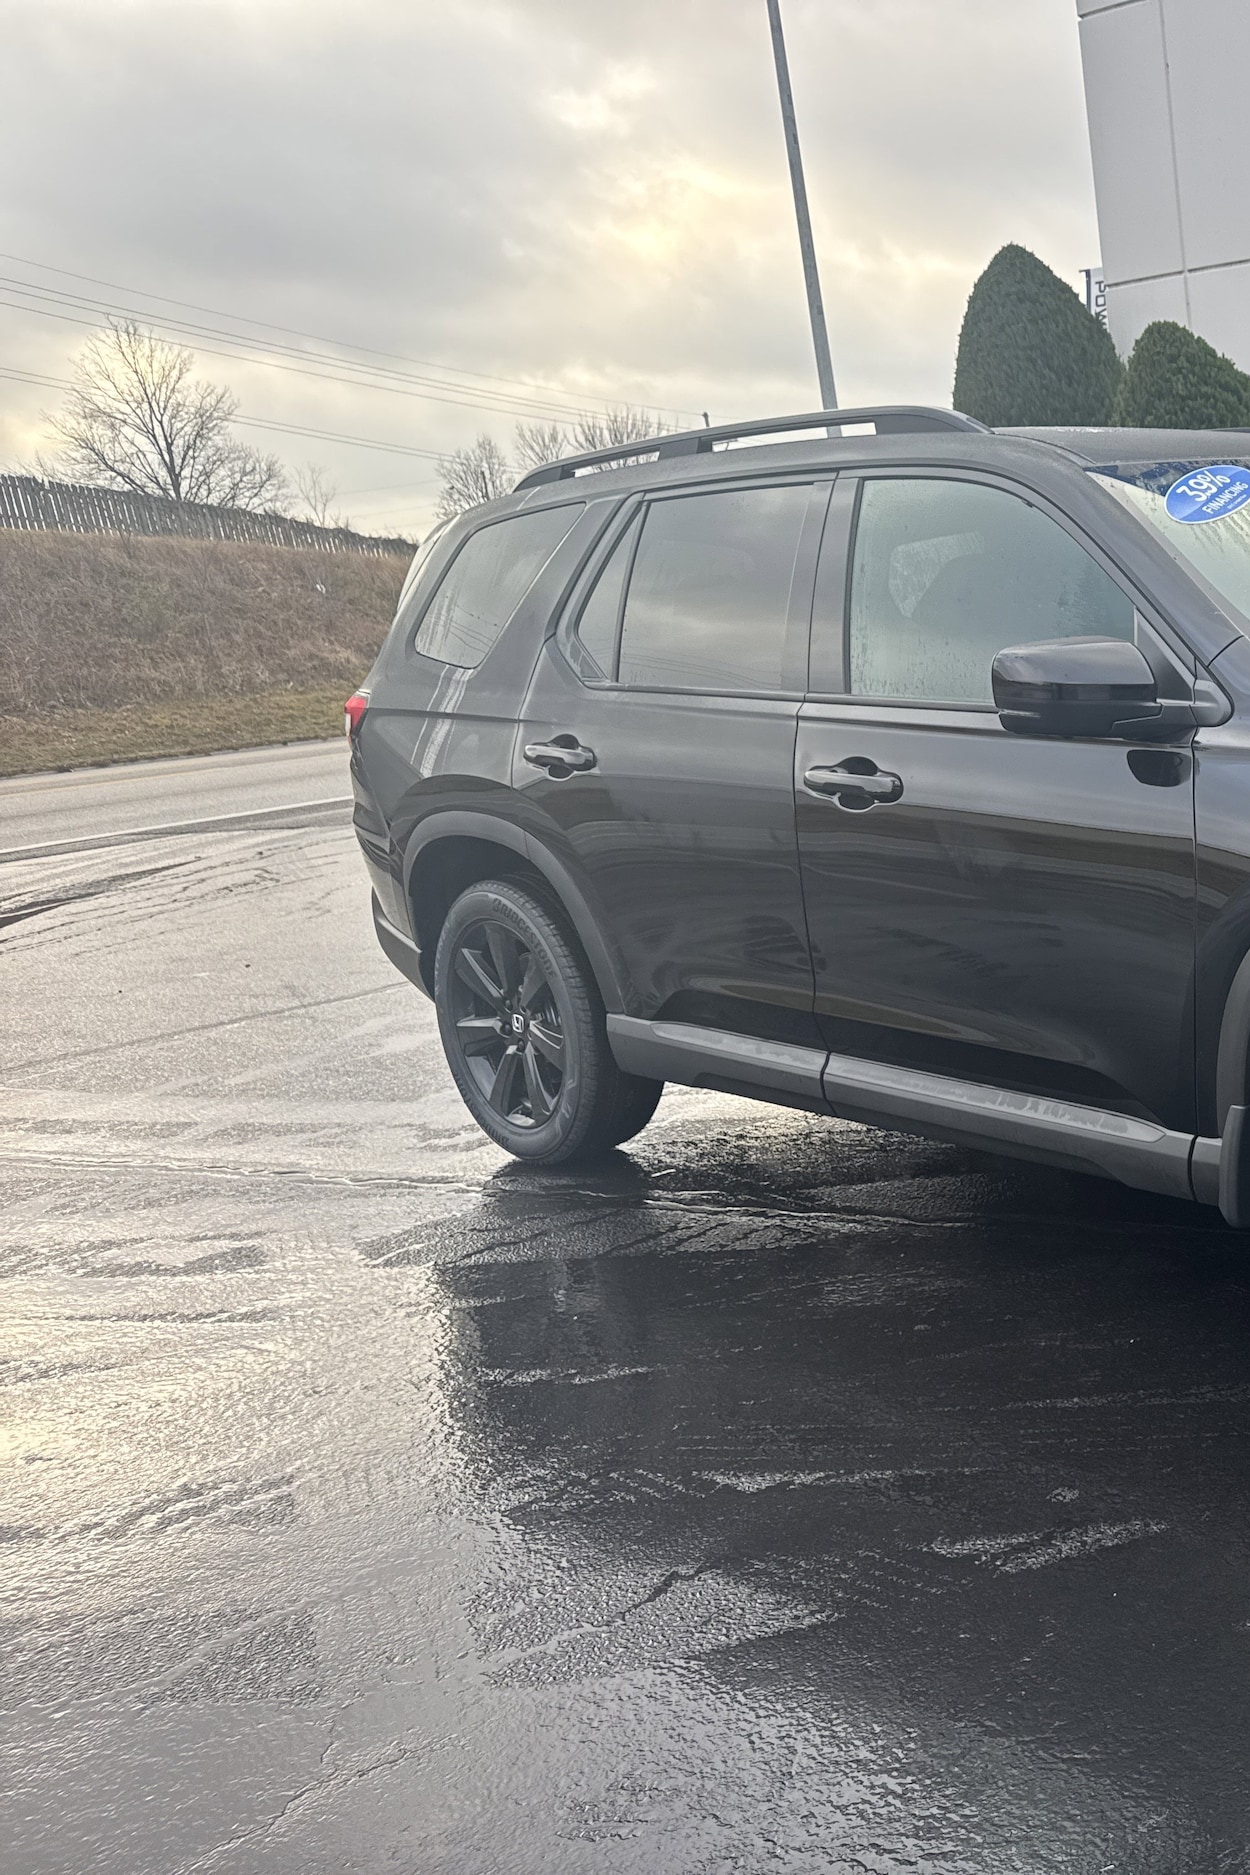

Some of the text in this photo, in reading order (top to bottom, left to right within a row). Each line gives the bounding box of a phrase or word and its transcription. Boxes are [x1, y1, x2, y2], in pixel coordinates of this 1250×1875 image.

[1176, 470, 1231, 502] 3.9%
[1202, 481, 1249, 514] FINANCING
[492, 898, 557, 977] BRIDGESTONE
